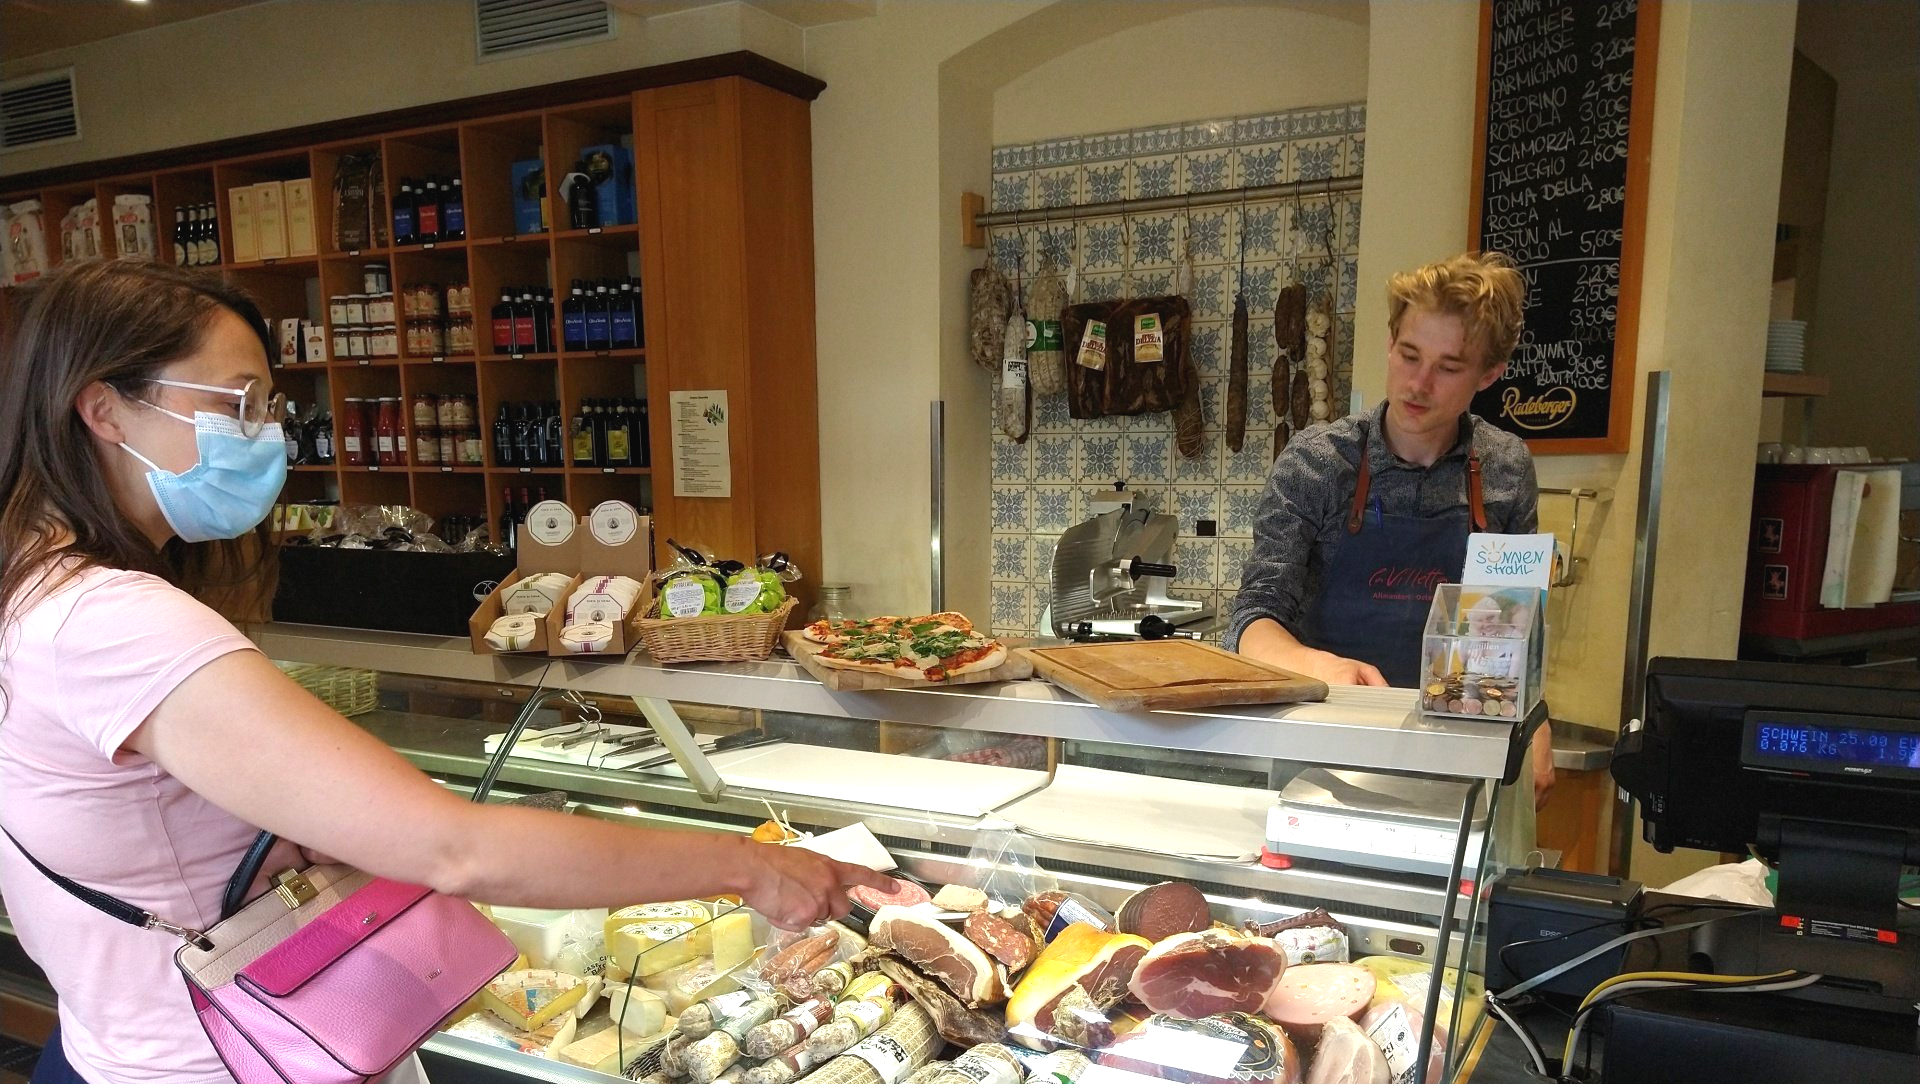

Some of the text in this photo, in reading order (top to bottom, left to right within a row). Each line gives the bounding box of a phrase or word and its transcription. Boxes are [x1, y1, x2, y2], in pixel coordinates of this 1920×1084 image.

[1490, 86, 1567, 121] PECORINO
[1489, 105, 1561, 143] ROBIOLA
[1488, 126, 1575, 167] SCAMORZA
[1487, 156, 1566, 193] TALEGGIO
[1487, 173, 1593, 214] TOMA DELLA
[1483, 217, 1573, 252] TESTUN AL
[1486, 207, 1539, 232] ROCCA
[1500, 386, 1574, 421] Radeberger
[1760, 740, 1807, 753] 0.076
[1818, 743, 1838, 755] KG
[1761, 727, 1829, 743] SCHWEIN
